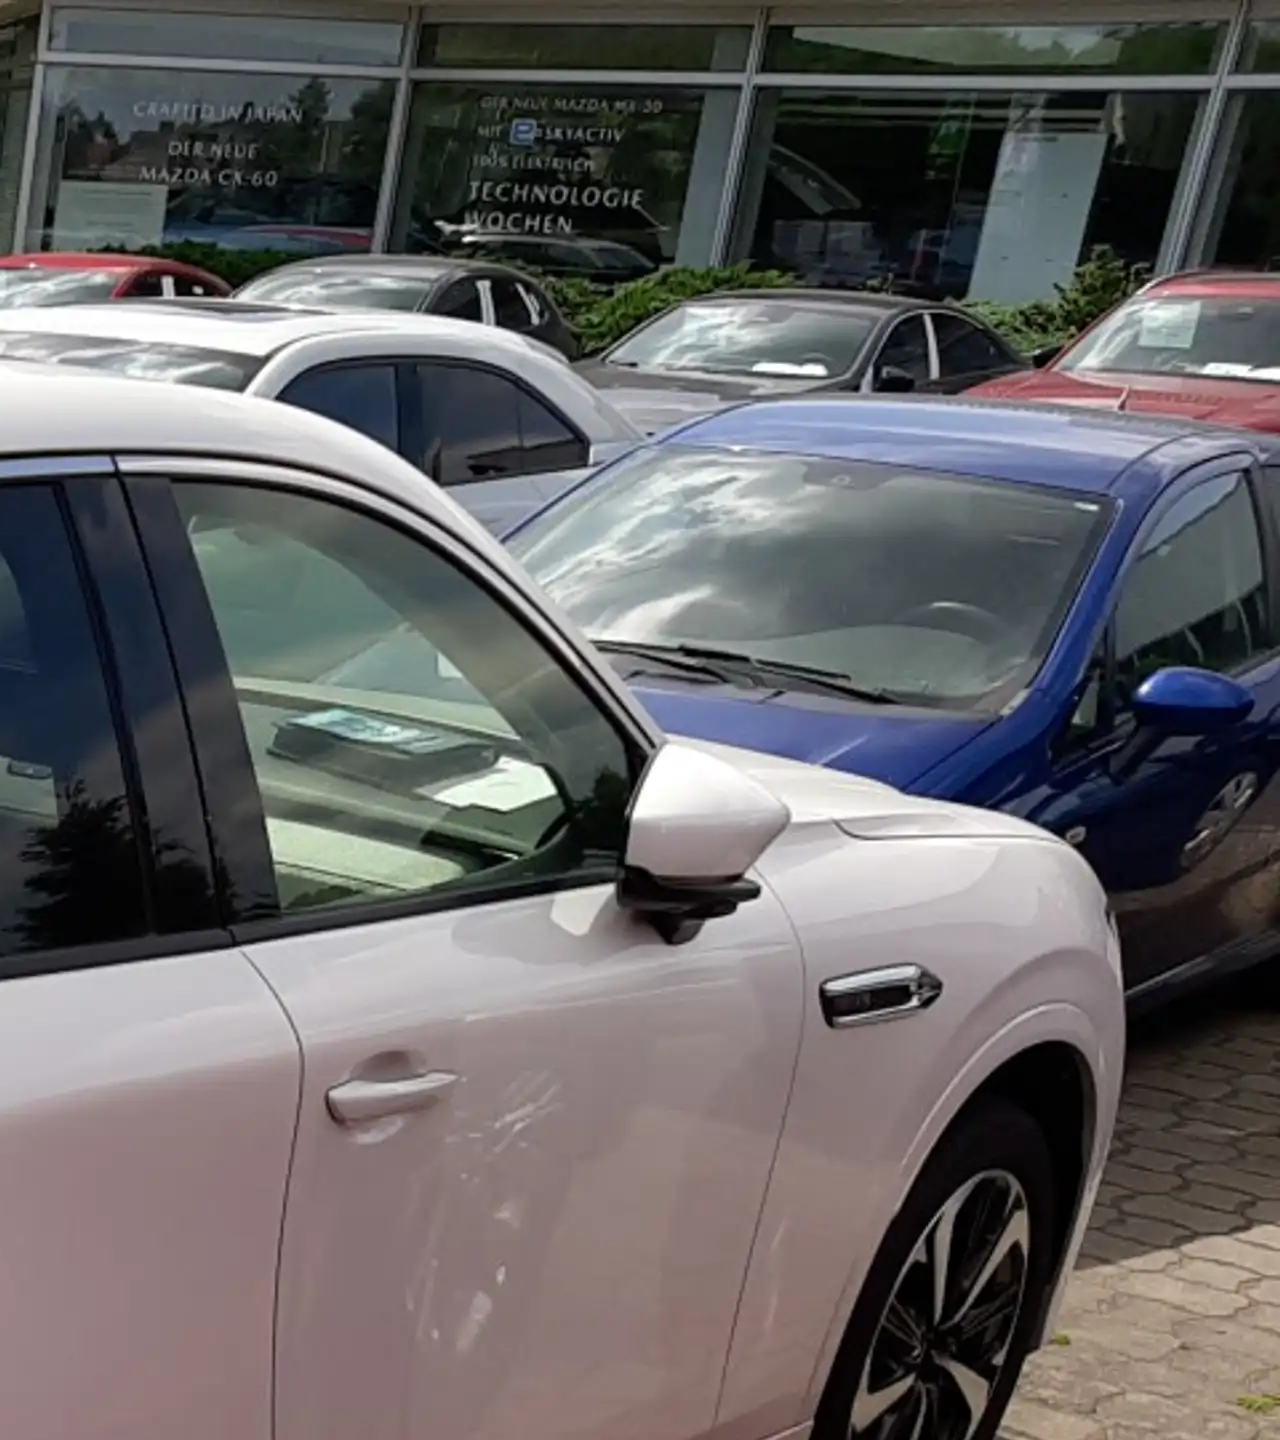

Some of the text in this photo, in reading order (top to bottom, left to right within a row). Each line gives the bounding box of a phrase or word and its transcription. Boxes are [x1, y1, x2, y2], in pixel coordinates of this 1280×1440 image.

[220, 105, 241, 122] IN
[243, 106, 304, 124] JAPAN
[553, 97, 610, 112] MAZDA
[167, 140, 260, 160] DER NEUE
[138, 165, 279, 188] MAZDA CX-60
[468, 181, 646, 210] TECHNOLOGIE
[464, 209, 573, 235] WOCHEN
